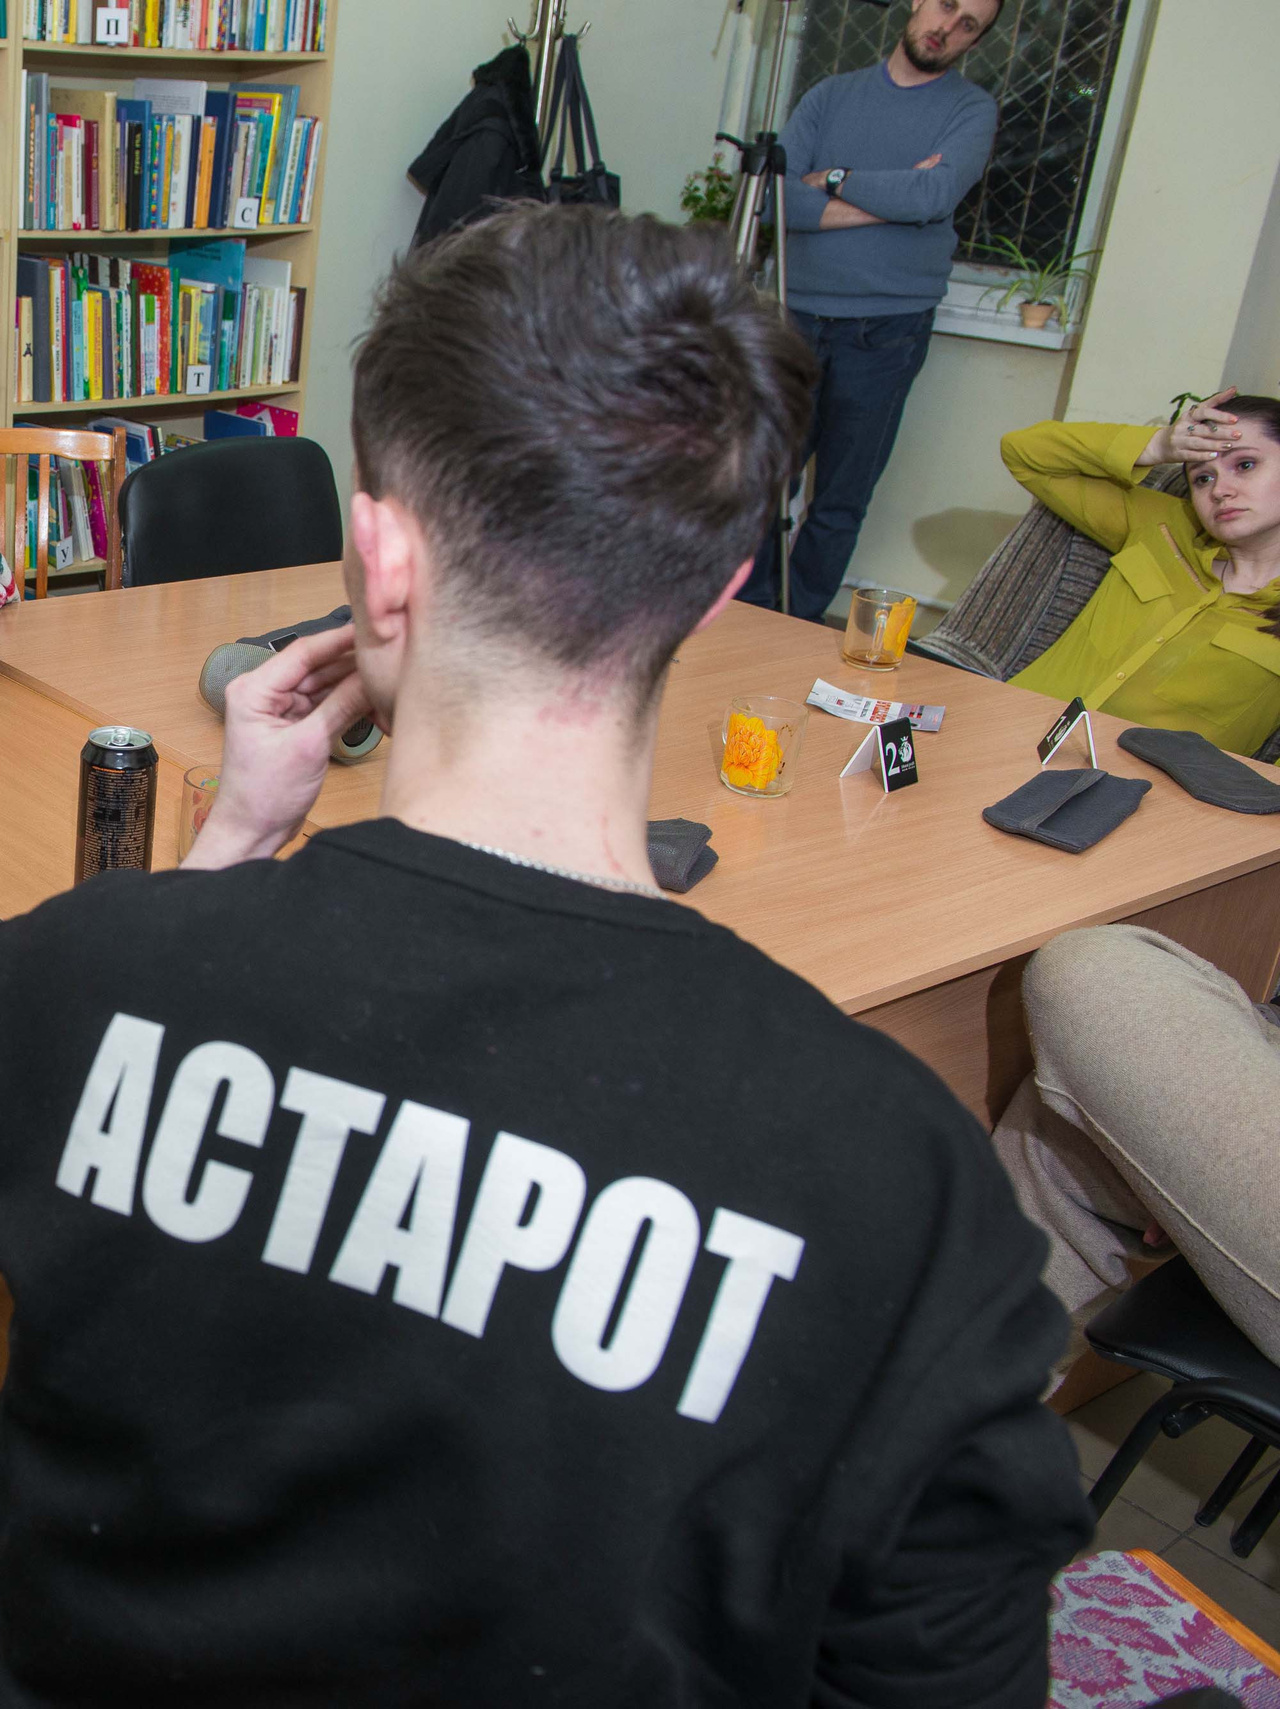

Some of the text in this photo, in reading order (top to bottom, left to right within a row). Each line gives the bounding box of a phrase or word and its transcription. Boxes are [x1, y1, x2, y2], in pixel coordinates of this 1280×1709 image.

[106, 18, 119, 35] П
[241, 207, 253, 223] С
[193, 372, 205, 388] Т
[1046, 716, 1067, 742] 1
[885, 742, 900, 777] 2
[55, 1012, 806, 1424] АСТАРОТ
